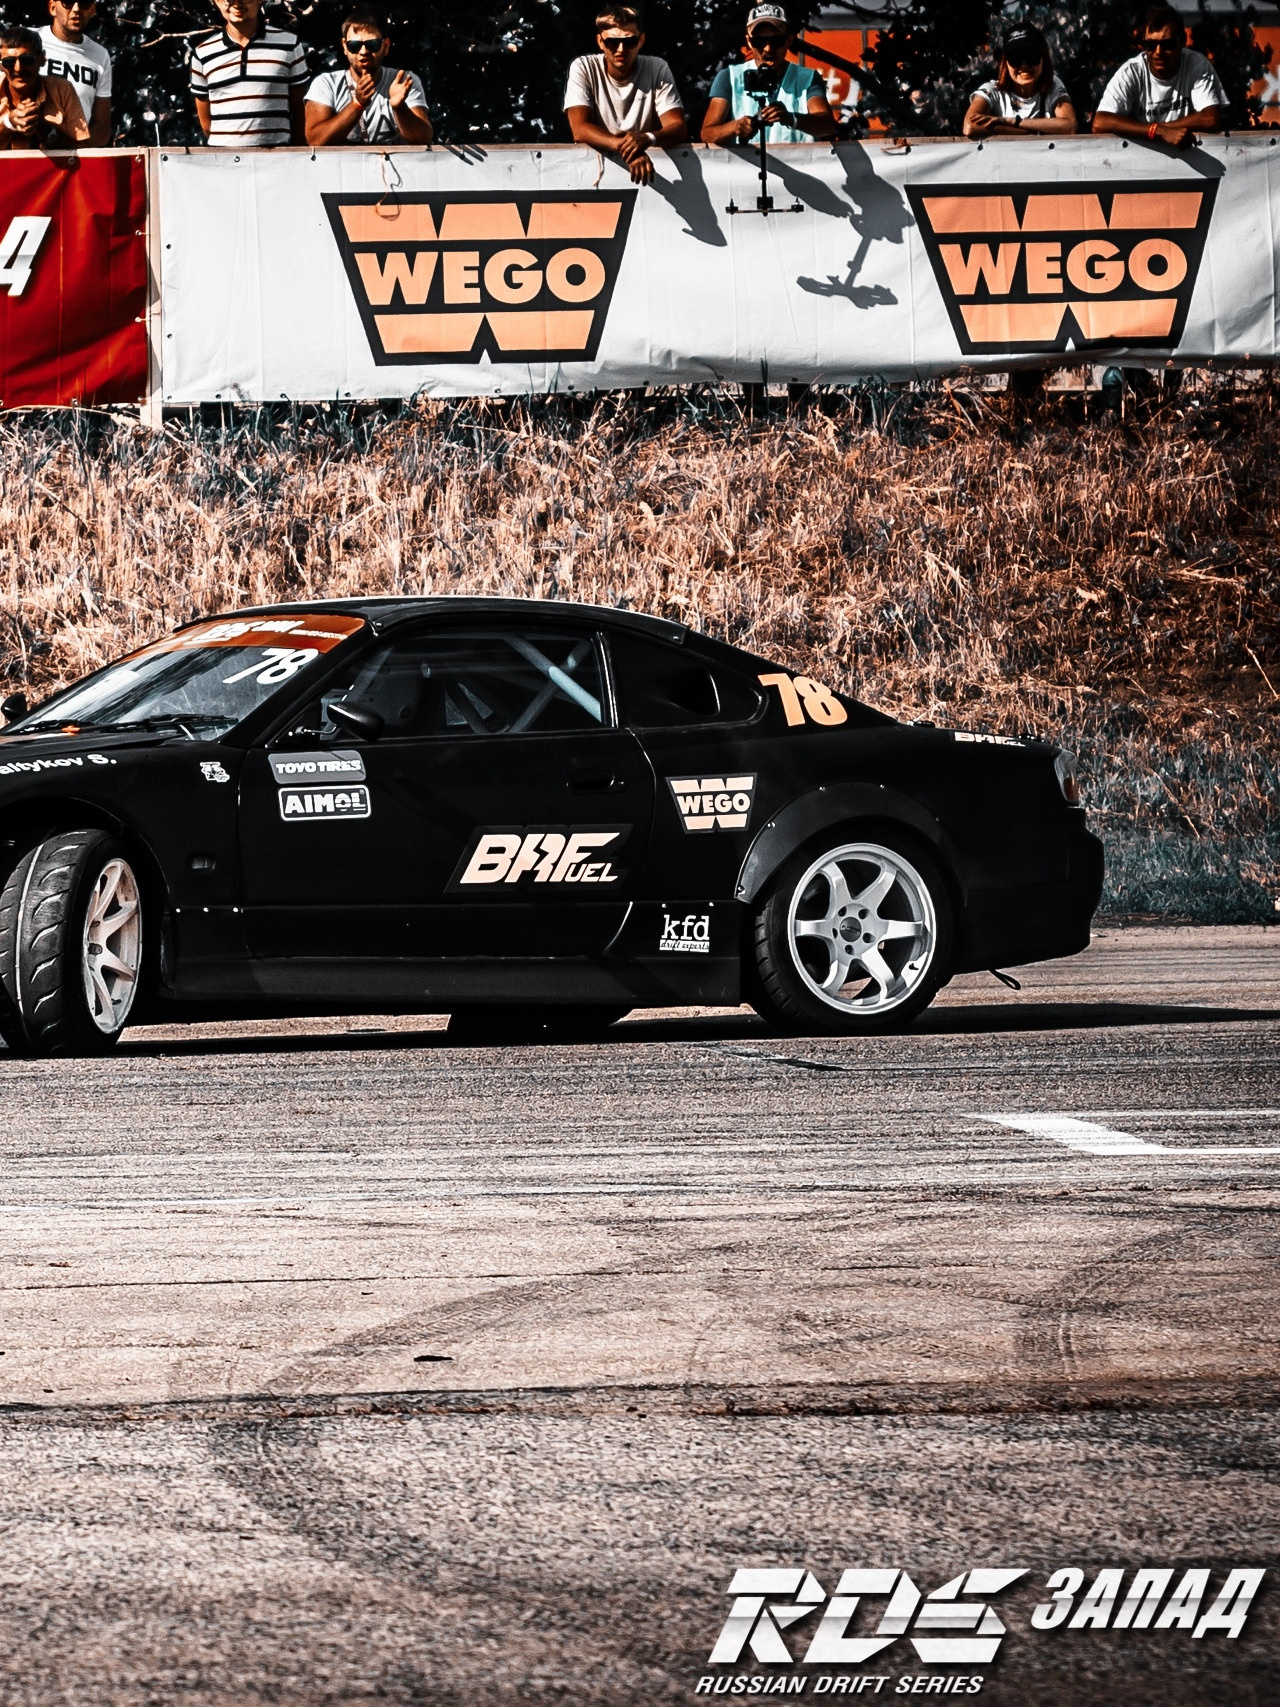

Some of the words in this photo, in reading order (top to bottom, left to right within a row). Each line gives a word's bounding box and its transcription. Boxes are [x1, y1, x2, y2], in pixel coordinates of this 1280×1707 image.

[354, 247, 606, 306] WEGO
[938, 238, 1188, 295] WEGO
[222, 648, 319, 685] 78
[757, 673, 848, 727] 78
[87, 753, 117, 765] S.
[275, 761, 317, 774] TOYO
[316, 759, 362, 773] TIRES
[284, 792, 367, 814] AIMOL
[676, 793, 751, 814] WEGO
[661, 914, 710, 940] kfd
